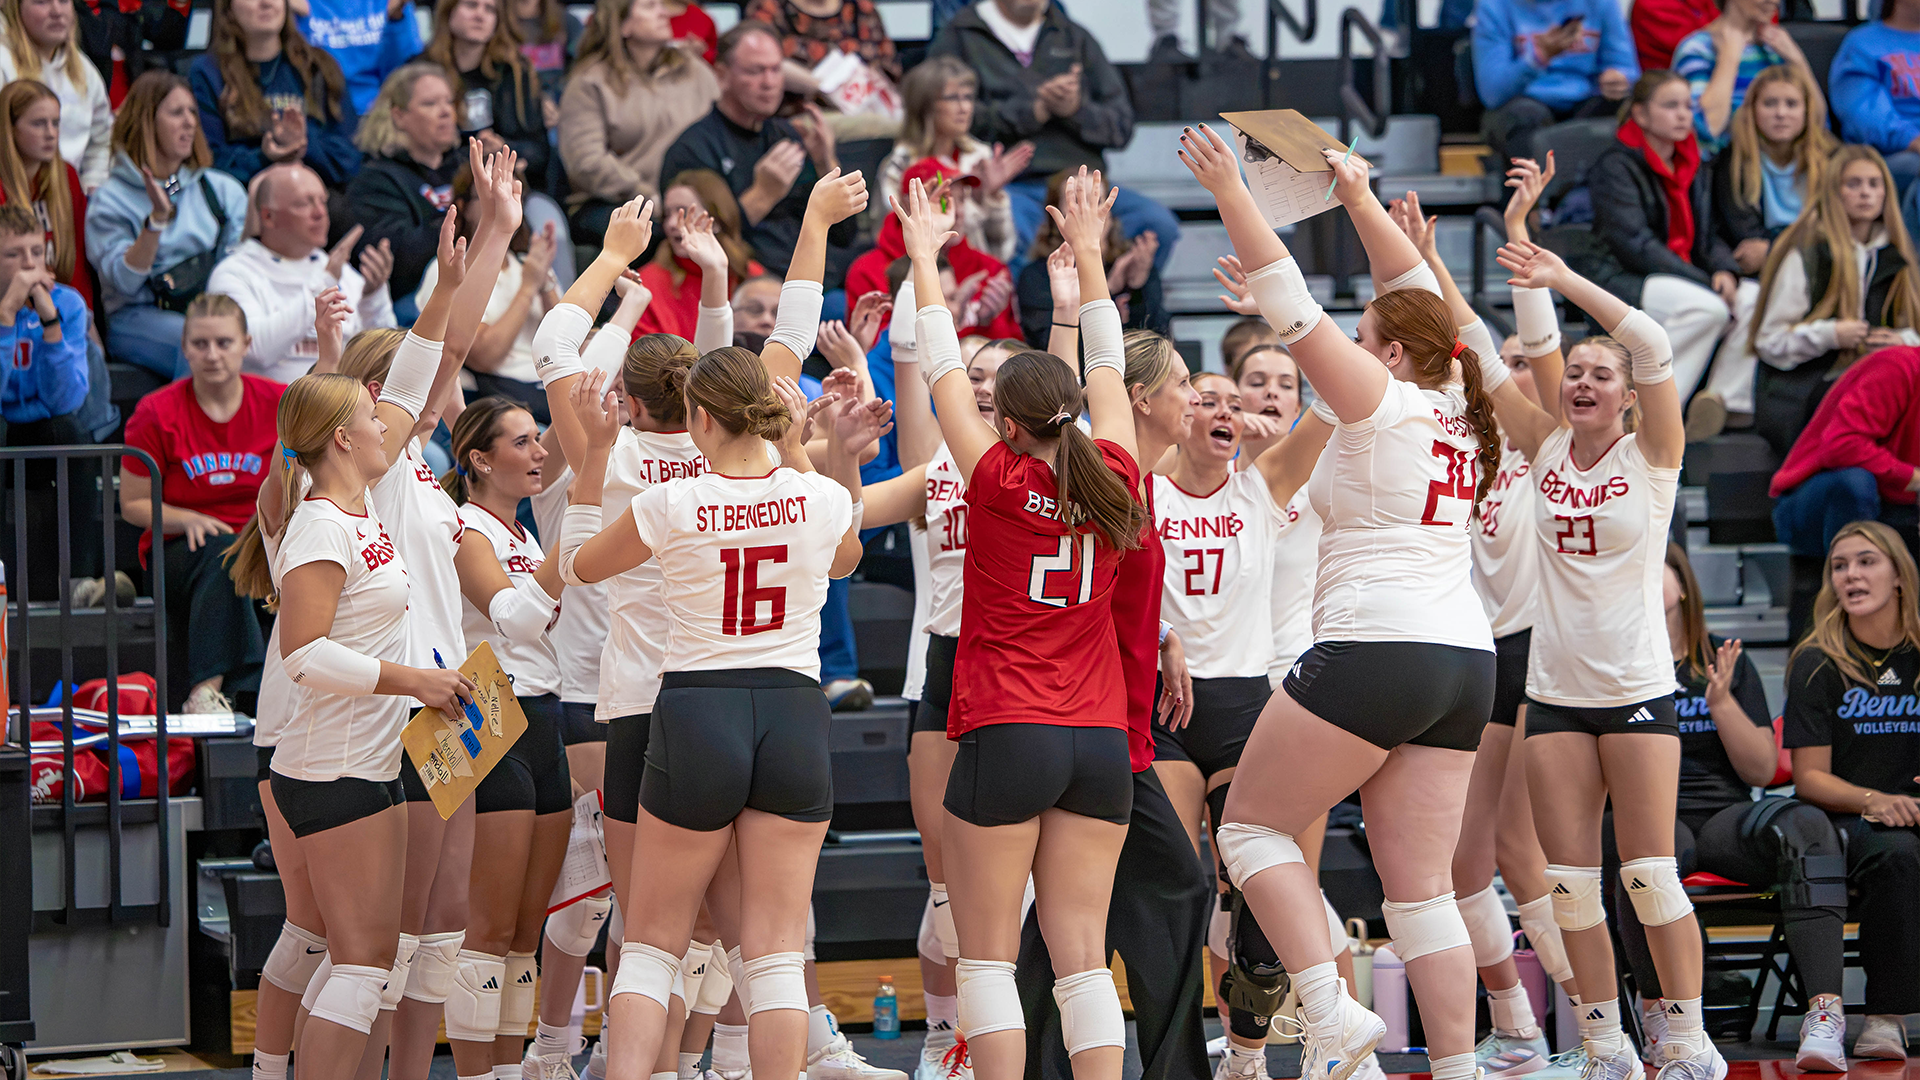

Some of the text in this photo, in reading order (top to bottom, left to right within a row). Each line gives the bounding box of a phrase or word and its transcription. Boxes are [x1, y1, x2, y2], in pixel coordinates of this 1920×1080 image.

[1540, 469, 1629, 508] BENNIES
[941, 505, 967, 551] 30
[1555, 514, 1597, 555] 23
[720, 544, 788, 636] 16
[1027, 532, 1096, 607] 21
[1184, 548, 1224, 596] 27
